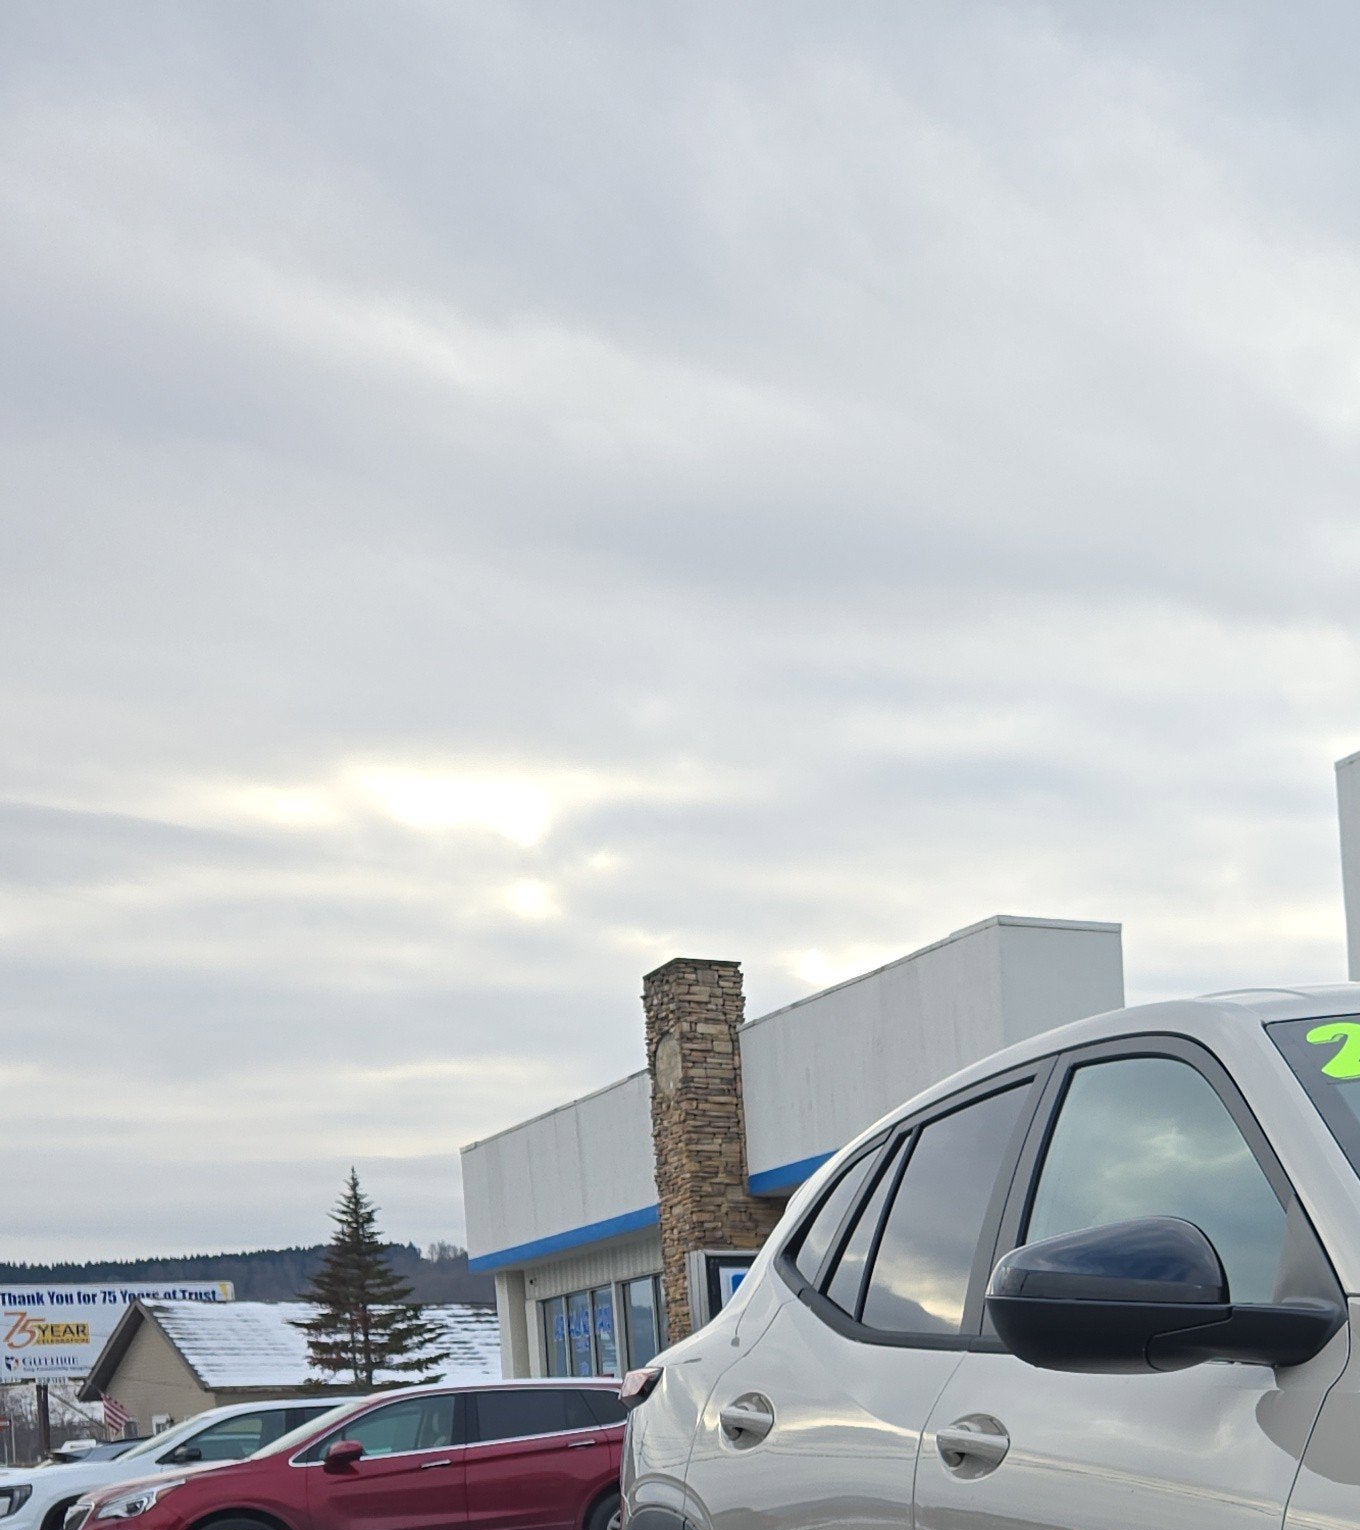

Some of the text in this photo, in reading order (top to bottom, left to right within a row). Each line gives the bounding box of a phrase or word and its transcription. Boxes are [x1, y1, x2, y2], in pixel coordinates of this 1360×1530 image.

[0, 1291, 45, 1307] Thank
[47, 1291, 76, 1305] You
[77, 1289, 98, 1305] for
[100, 1290, 118, 1304] 75
[179, 1288, 218, 1302] Trust
[4, 1311, 88, 1349] 75 YEAR
